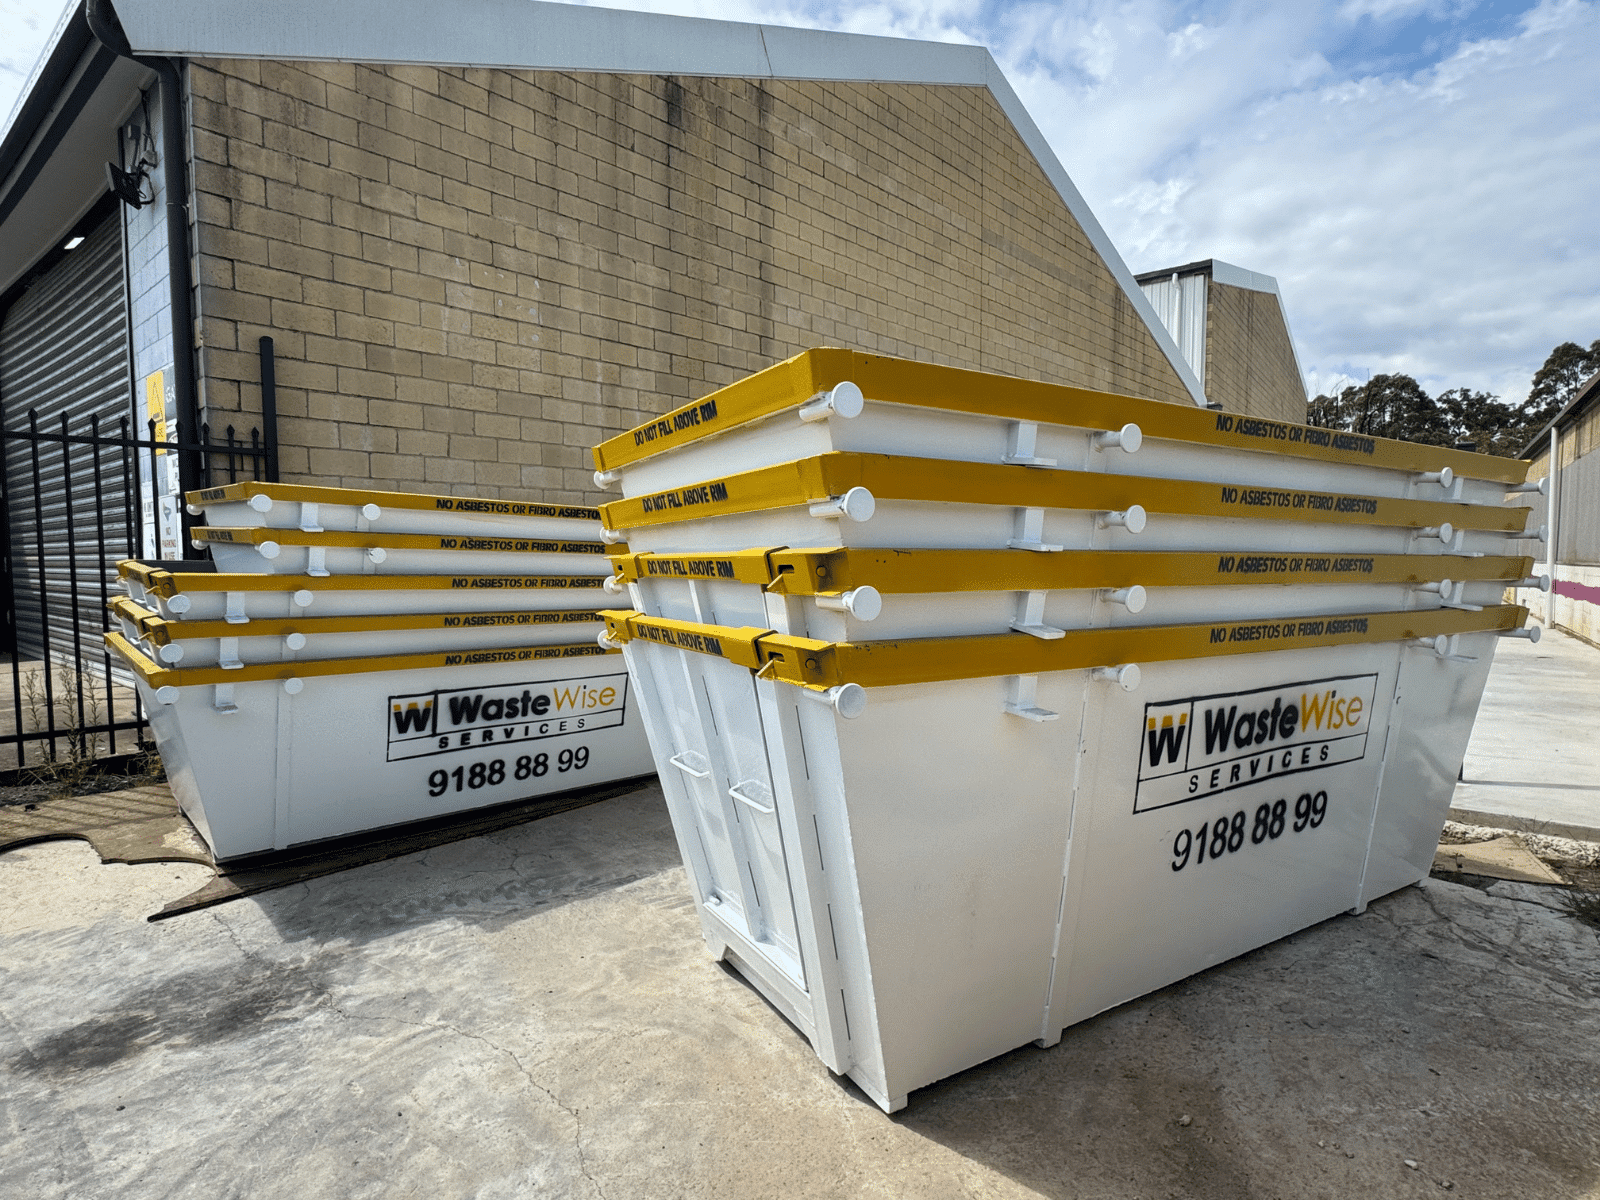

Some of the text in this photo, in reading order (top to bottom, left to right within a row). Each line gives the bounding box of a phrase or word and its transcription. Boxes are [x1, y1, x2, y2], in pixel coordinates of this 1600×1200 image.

[634, 400, 717, 446] DO NOT FILL ABOVE RIM
[1216, 414, 1374, 454] NO ASBESTOS OR FIBRO ASBESTOS
[436, 499, 453, 509] NO
[456, 501, 509, 513] ASBESTOS
[512, 504, 525, 514] OR
[528, 506, 556, 516] FIBRO
[642, 482, 728, 512] DO NOT FILL ABOVE RIM
[1222, 487, 1377, 514] NO ASBESTOS OR FIBRO ASBESTOS
[441, 539, 606, 554] NO ASBESTOS OR FIBRO ASBESTOS
[647, 560, 735, 578] DO NOT FILL ABOVE RIM
[1218, 557, 1374, 573] NO ASBESTOS OR FIBRO ASBESTOS
[452, 579, 468, 588] NO
[471, 579, 522, 588] ASBESTOS
[524, 579, 538, 587] OR
[541, 579, 566, 587] FIBRO
[444, 617, 460, 626] NO
[463, 615, 515, 626] ASBESTOS
[517, 614, 531, 624] OR
[534, 613, 560, 623] FIBRO
[1210, 618, 1368, 643] NO ASBESTOS OR FIBRO ASBESTOS
[637, 624, 722, 655] DO NOT FILL ABOVE RIM
[445, 655, 462, 665] NO
[464, 653, 516, 664] ASBESTOS
[518, 651, 532, 660] OR
[534, 649, 560, 658] FIBRO
[438, 718, 585, 749] SERVICES
[428, 746, 590, 797] 9188 88 99
[1189, 744, 1329, 793] SERVICES
[1172, 791, 1328, 872] 9188 88 99
